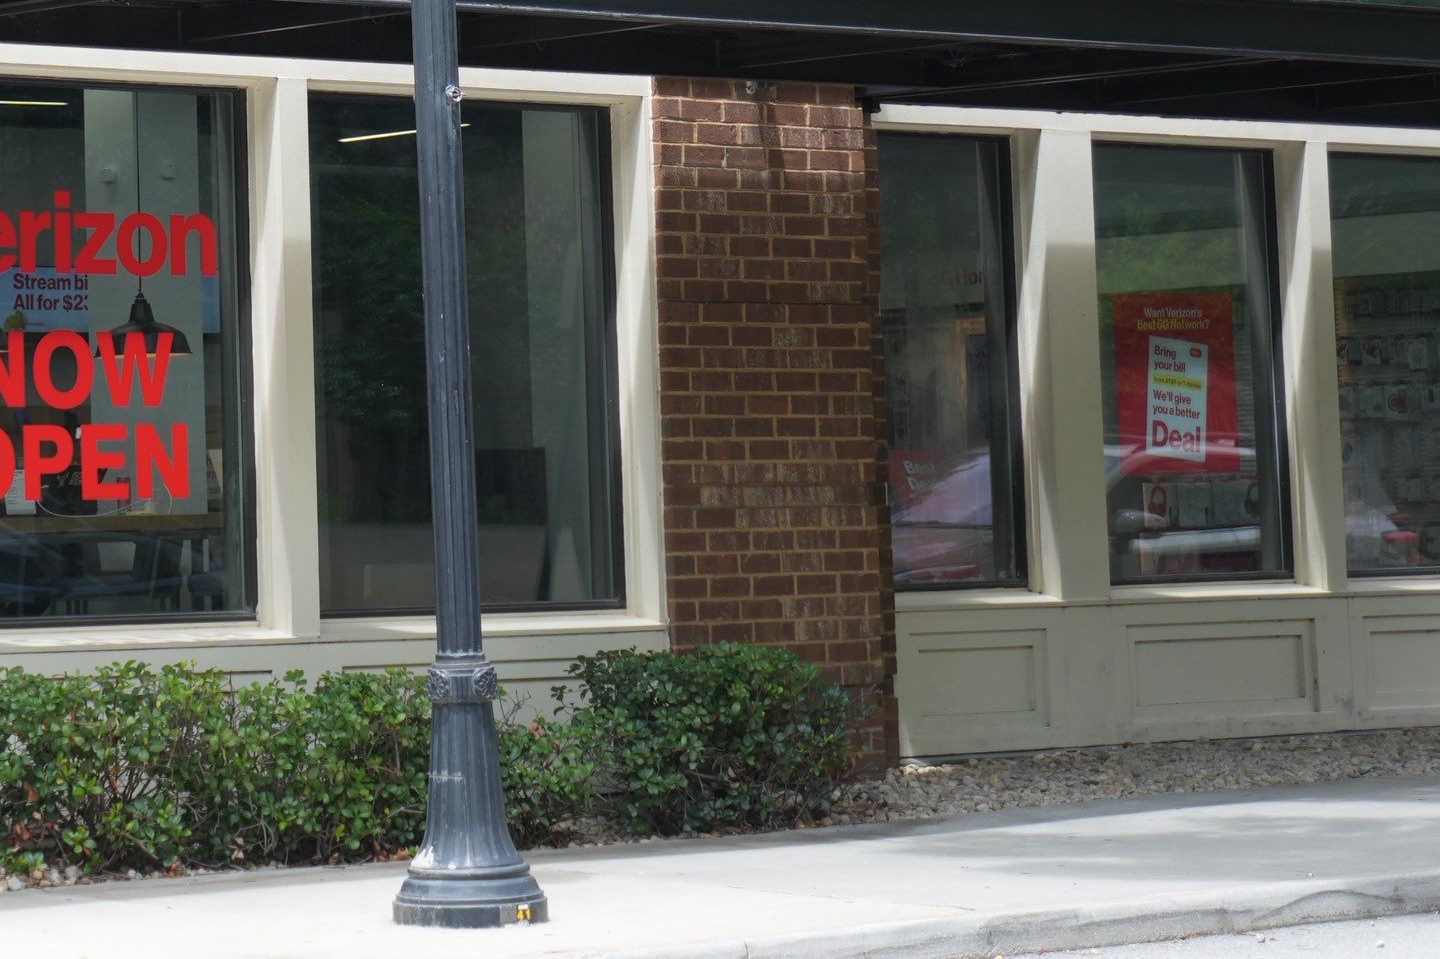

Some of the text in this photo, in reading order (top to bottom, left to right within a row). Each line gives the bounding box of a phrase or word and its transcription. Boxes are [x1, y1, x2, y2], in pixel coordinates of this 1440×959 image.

[13, 272, 88, 290] Stream bi
[13, 293, 89, 312] All for $2
[1143, 305, 1202, 318] Want Verizon's
[1137, 320, 1157, 330] Best
[1154, 345, 1177, 361] Bring
[1153, 360, 1186, 373] your bill
[1153, 389, 1191, 405] We'll give
[1152, 404, 1200, 419] you a better
[1152, 420, 1201, 453] Deal
